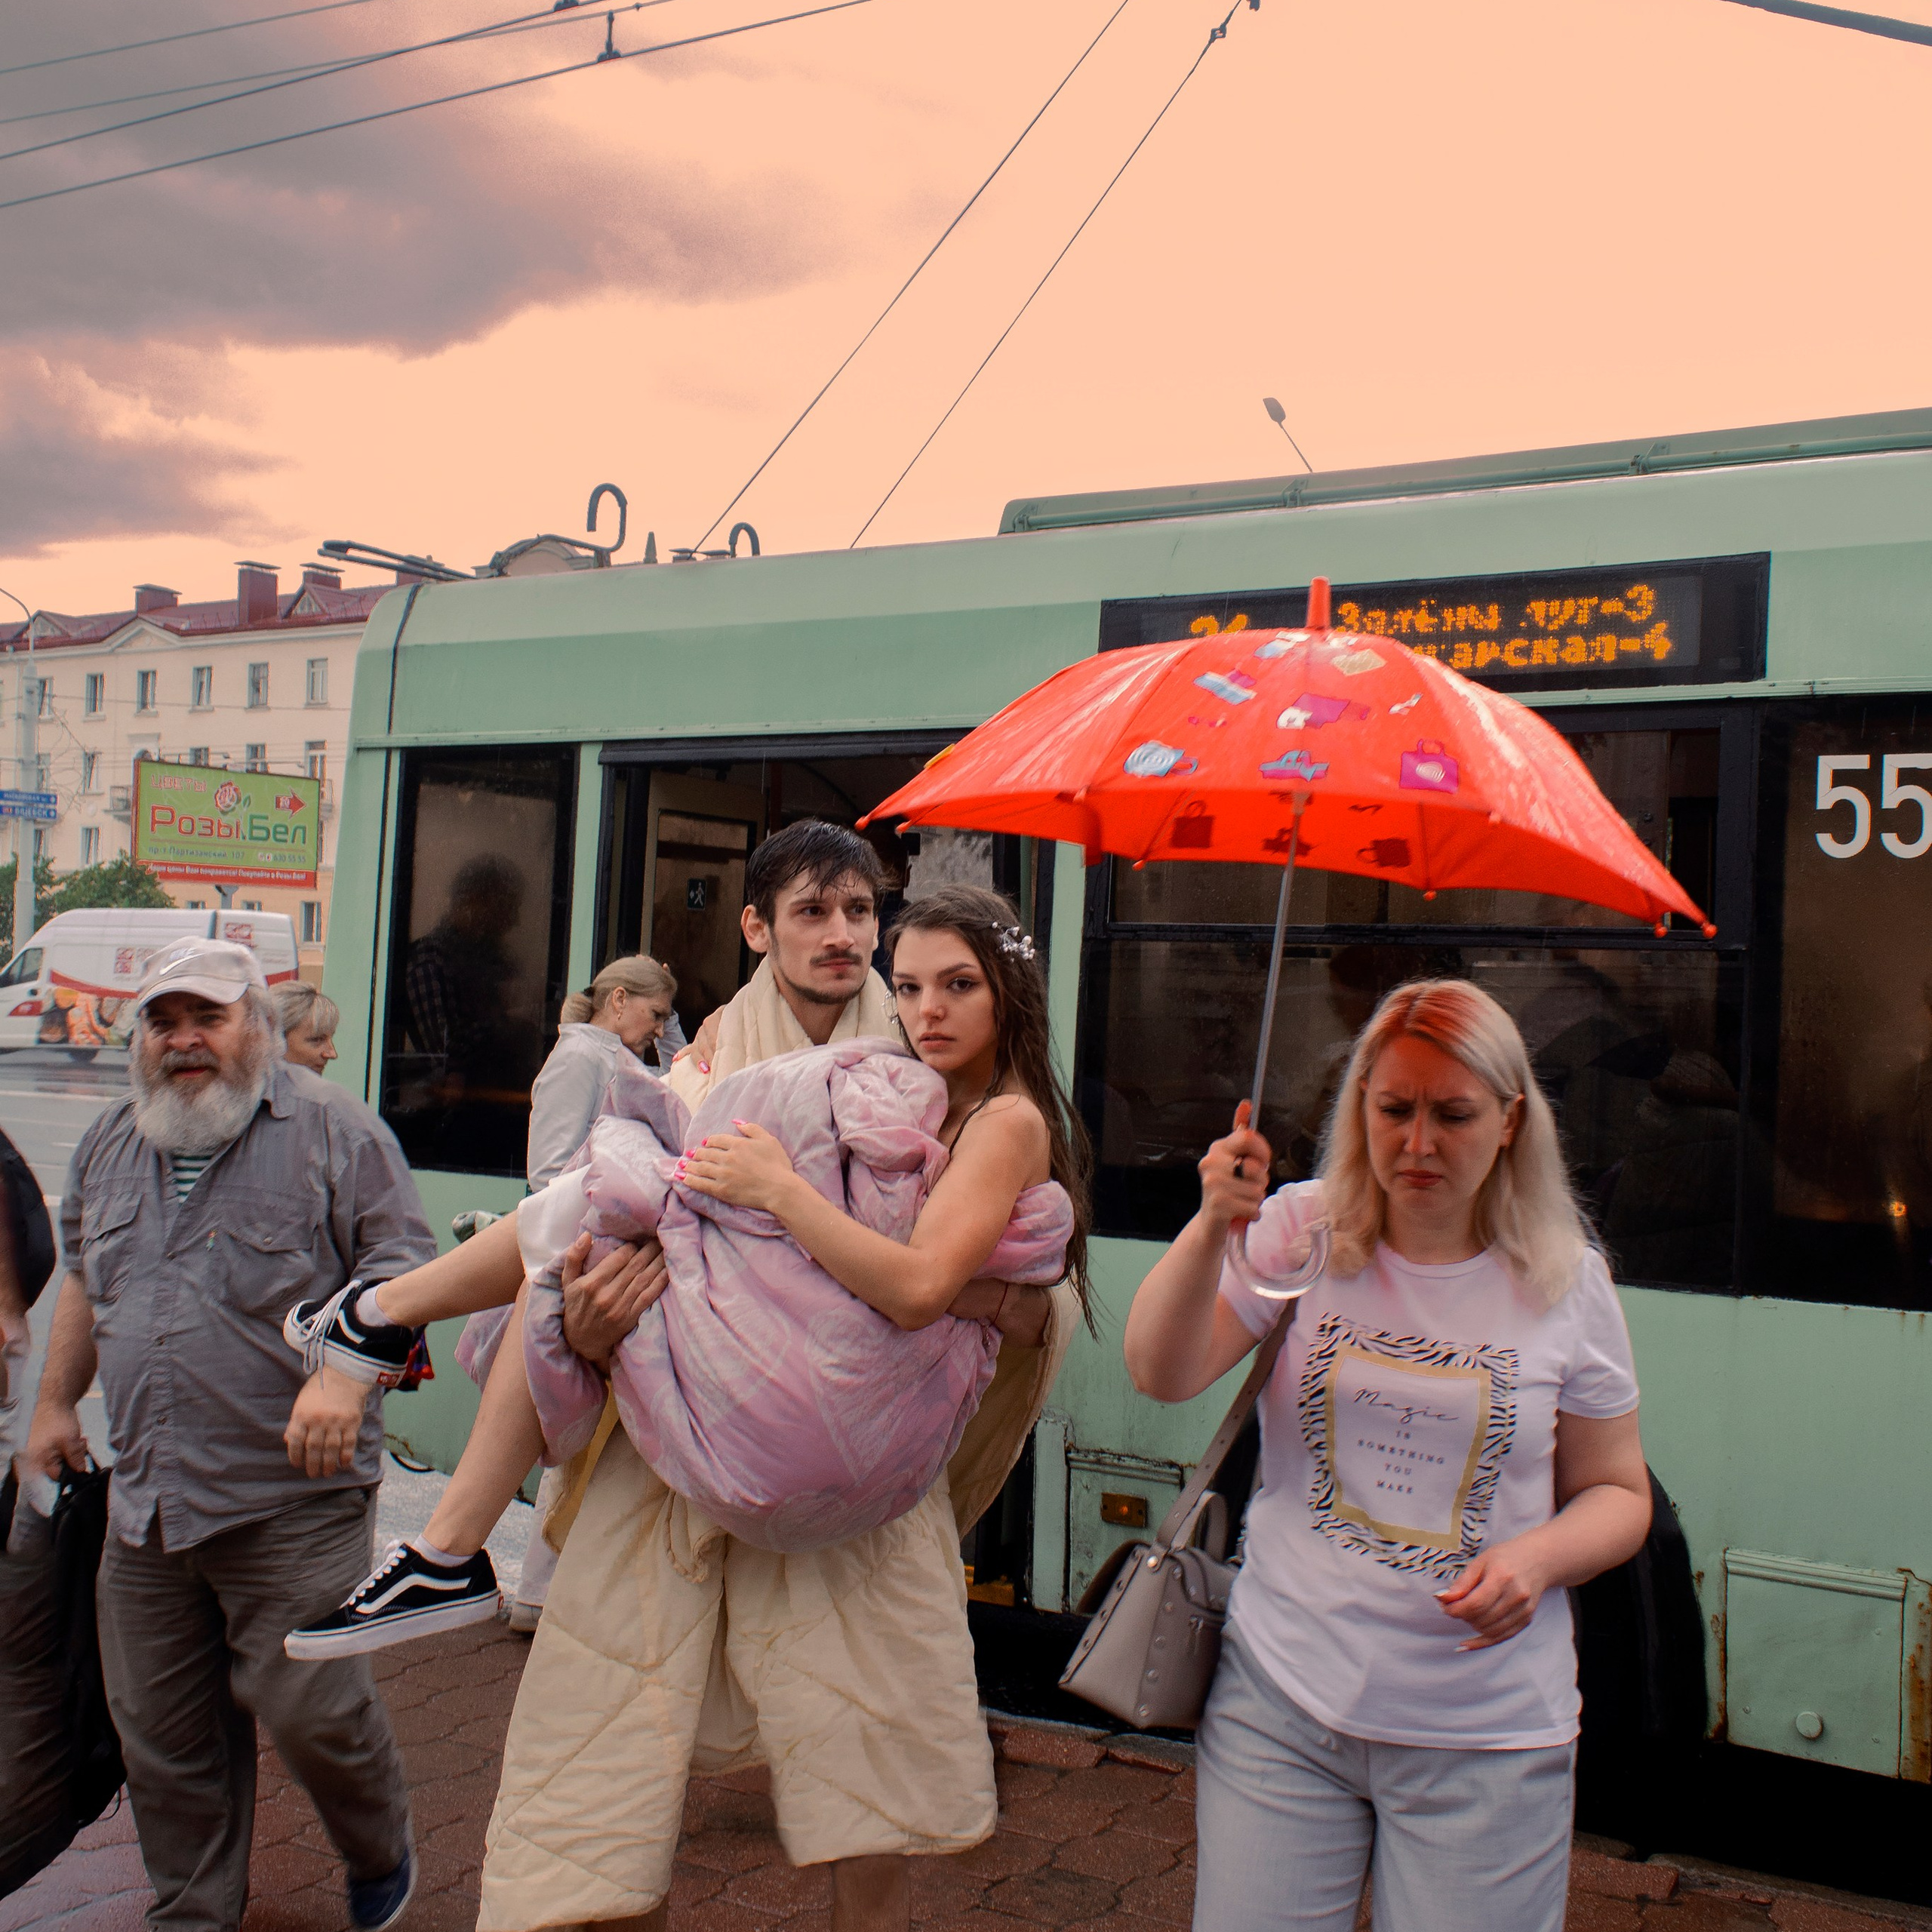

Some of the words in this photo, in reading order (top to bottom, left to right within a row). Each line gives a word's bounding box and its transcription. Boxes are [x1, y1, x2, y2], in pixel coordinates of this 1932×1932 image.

[1412, 621, 1672, 670] арская-4
[1816, 753, 1932, 859] 55
[1354, 1387, 1460, 1425] Magic
[1358, 1438, 1444, 1464] SOMETHING
[1385, 1463, 1412, 1475] YOU
[1377, 1480, 1414, 1494] MAKE
